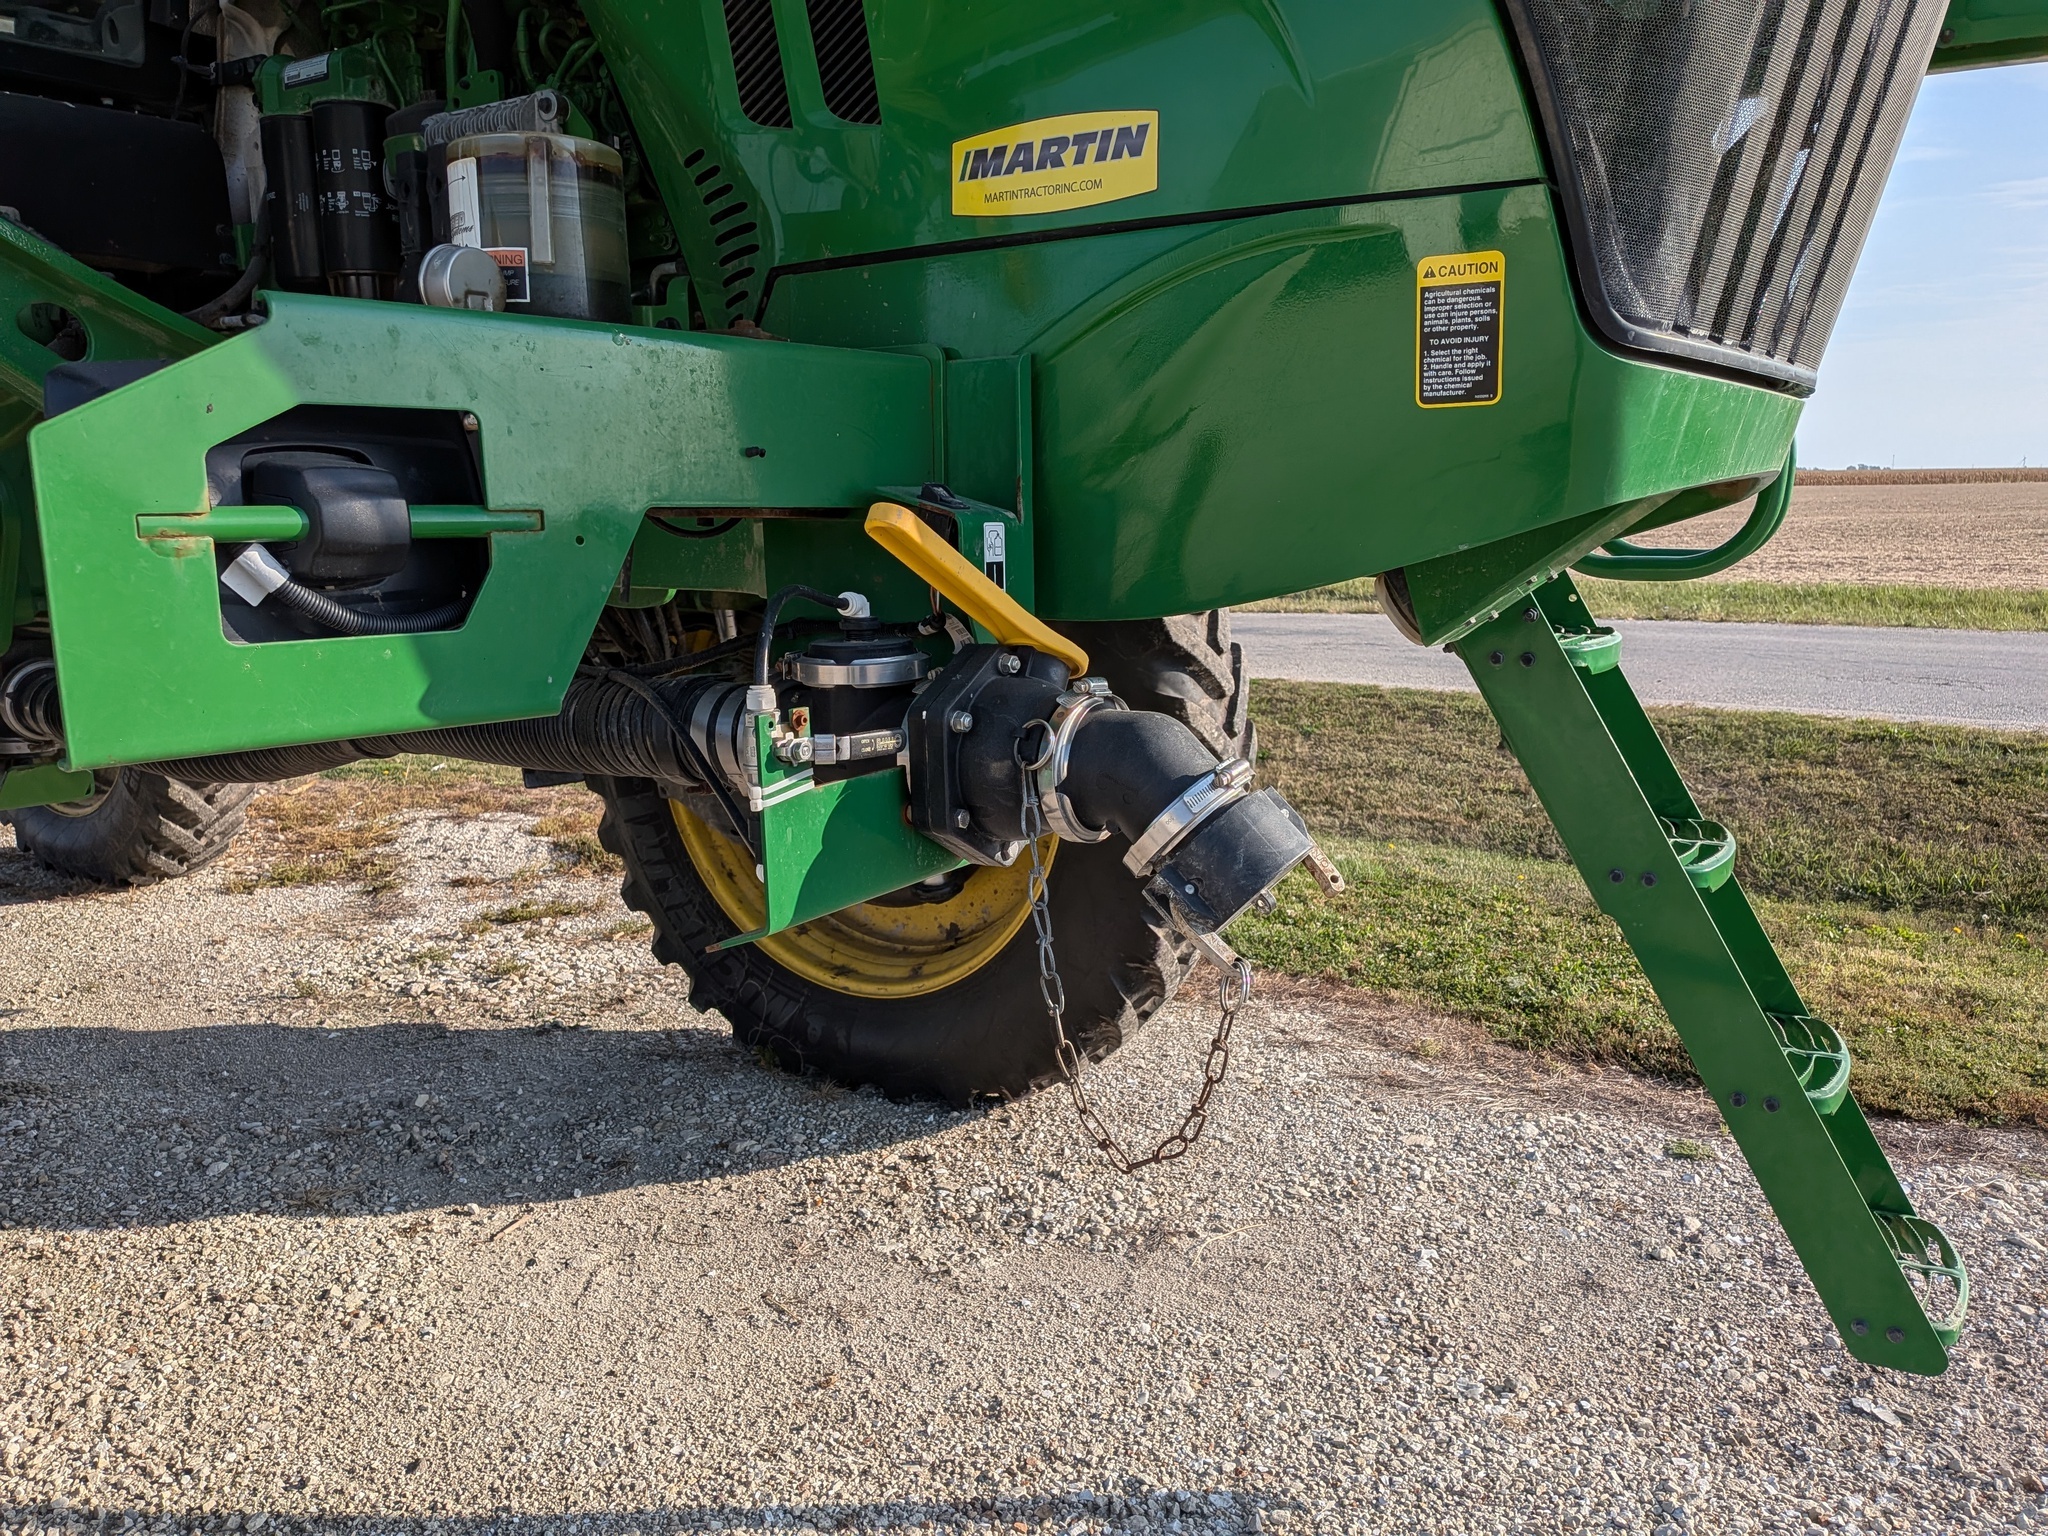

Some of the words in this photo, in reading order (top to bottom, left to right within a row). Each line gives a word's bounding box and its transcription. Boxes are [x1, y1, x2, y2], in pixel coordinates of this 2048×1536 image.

[966, 123, 1150, 181] MARTIN
[984, 178, 1103, 204] MARTINTRACTORINC.COM
[491, 254, 523, 265] NING
[1439, 261, 1498, 277] CAUTION
[1425, 290, 1461, 299] Agricultural
[1463, 287, 1495, 295] chemicals
[1450, 310, 1468, 319] injure
[1450, 324, 1479, 332] property.
